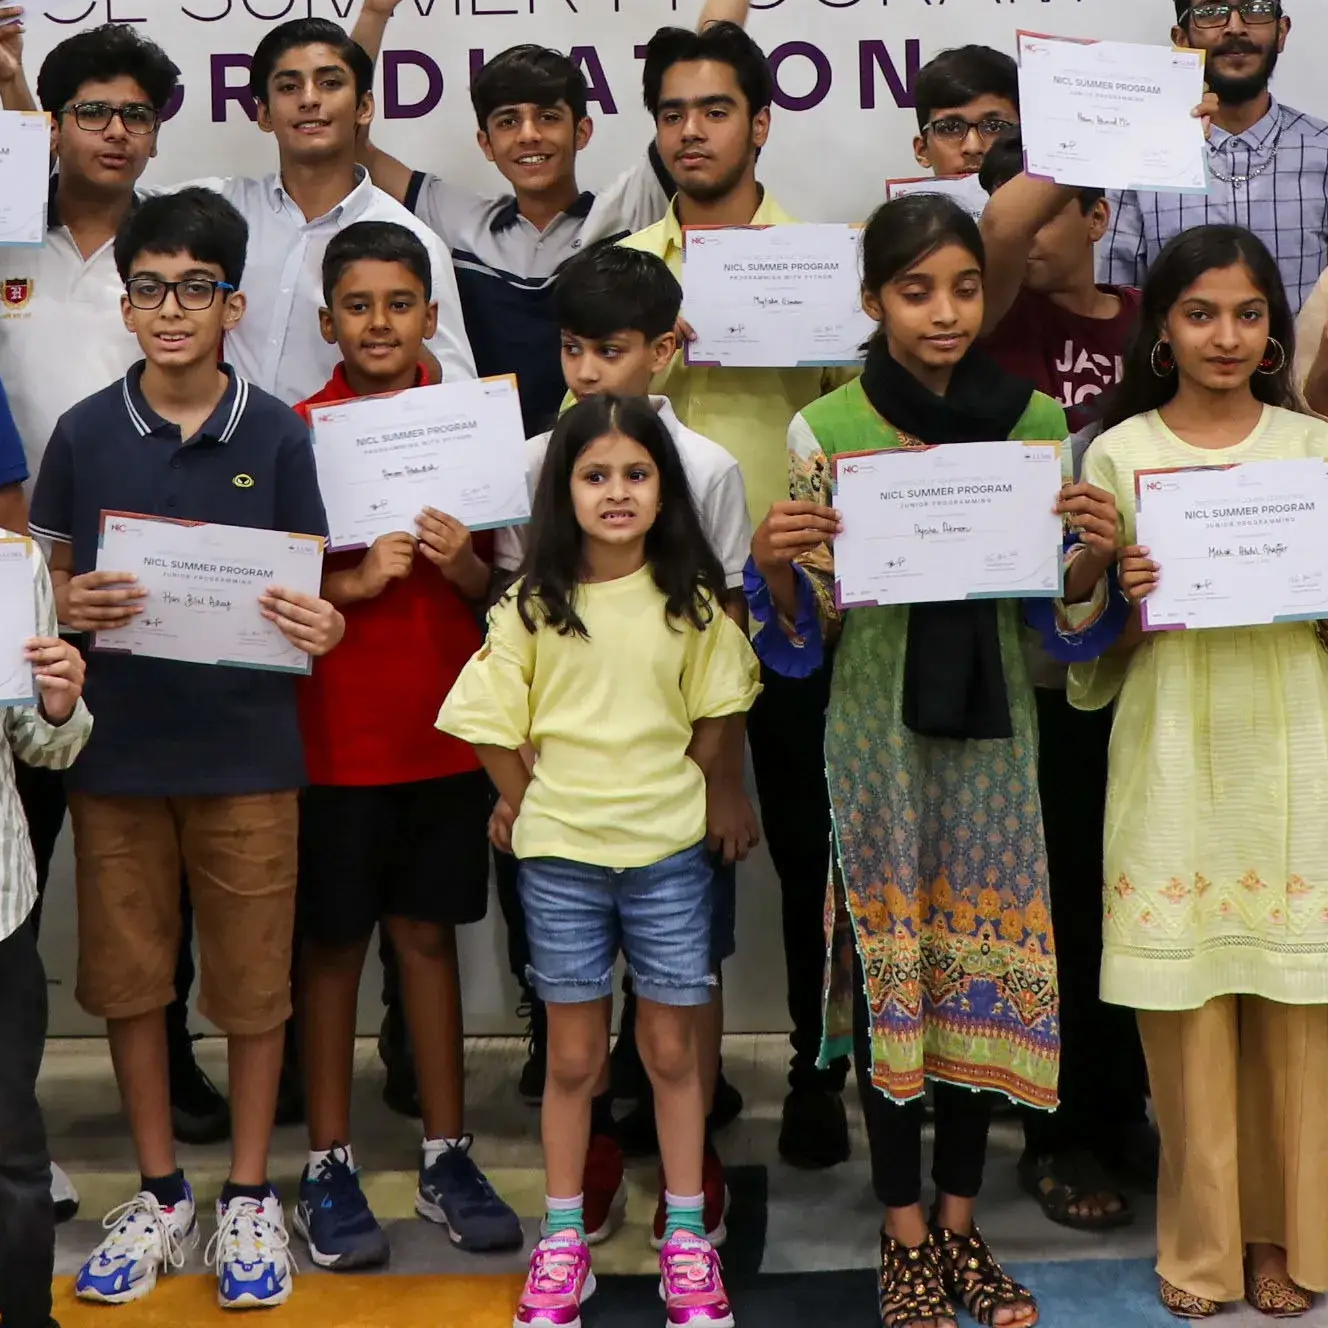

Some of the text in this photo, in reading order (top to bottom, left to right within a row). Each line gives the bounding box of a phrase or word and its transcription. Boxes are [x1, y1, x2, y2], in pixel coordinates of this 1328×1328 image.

[1053, 76, 1161, 94] NICL SUMMER PROGRAM
[748, 263, 788, 271] SUMMER
[356, 437, 378, 446] NICL
[381, 429, 425, 443] SUMMER
[427, 421, 477, 435] PROGRAM
[843, 465, 858, 474] NIC
[880, 484, 1012, 500] NICL SUMMER PROGRAM
[1146, 482, 1161, 490] NIC
[1184, 502, 1315, 519] NICL SUMMER PROGRAM
[143, 557, 274, 578] NICL SUMMER PROGRAM
